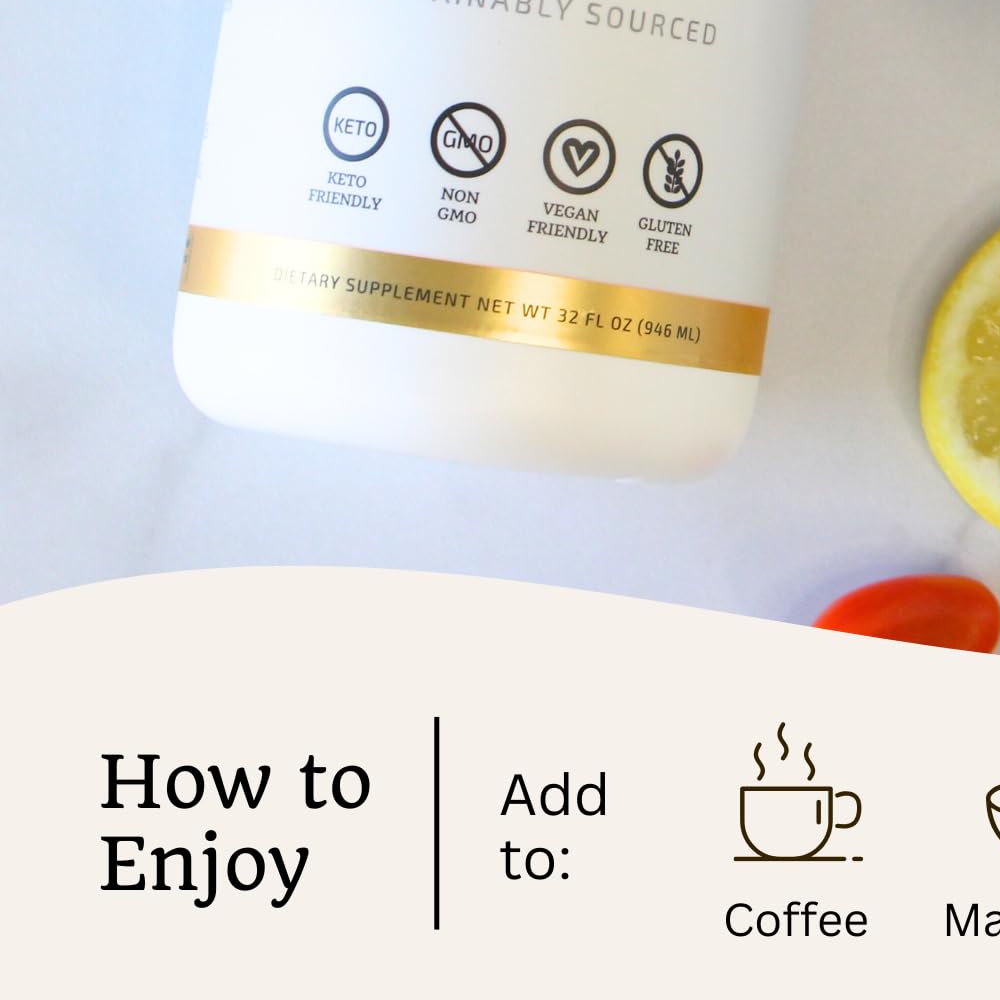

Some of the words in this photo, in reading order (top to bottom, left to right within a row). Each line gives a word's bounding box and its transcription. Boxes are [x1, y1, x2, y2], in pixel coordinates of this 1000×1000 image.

[585, 2, 718, 46] SOURCED
[334, 118, 377, 138] KETO
[442, 130, 493, 154] GMO
[326, 170, 367, 188] KETO
[308, 189, 382, 211] FRIENDLY
[440, 186, 480, 204] NON
[437, 206, 478, 225] GMO
[542, 202, 599, 223] VEGAN
[526, 220, 608, 245] FRIENDLY
[638, 216, 692, 238] GLUTEN
[646, 236, 680, 256] FREE
[274, 266, 340, 292] DIETARY
[346, 276, 472, 310] SUPPLEMENT
[477, 296, 516, 316] NET
[520, 303, 551, 320] WT
[557, 308, 579, 326] 32
[584, 312, 604, 329] FL
[610, 314, 632, 332] OZ
[636, 318, 672, 338] (946
[676, 323, 701, 344] ML)
